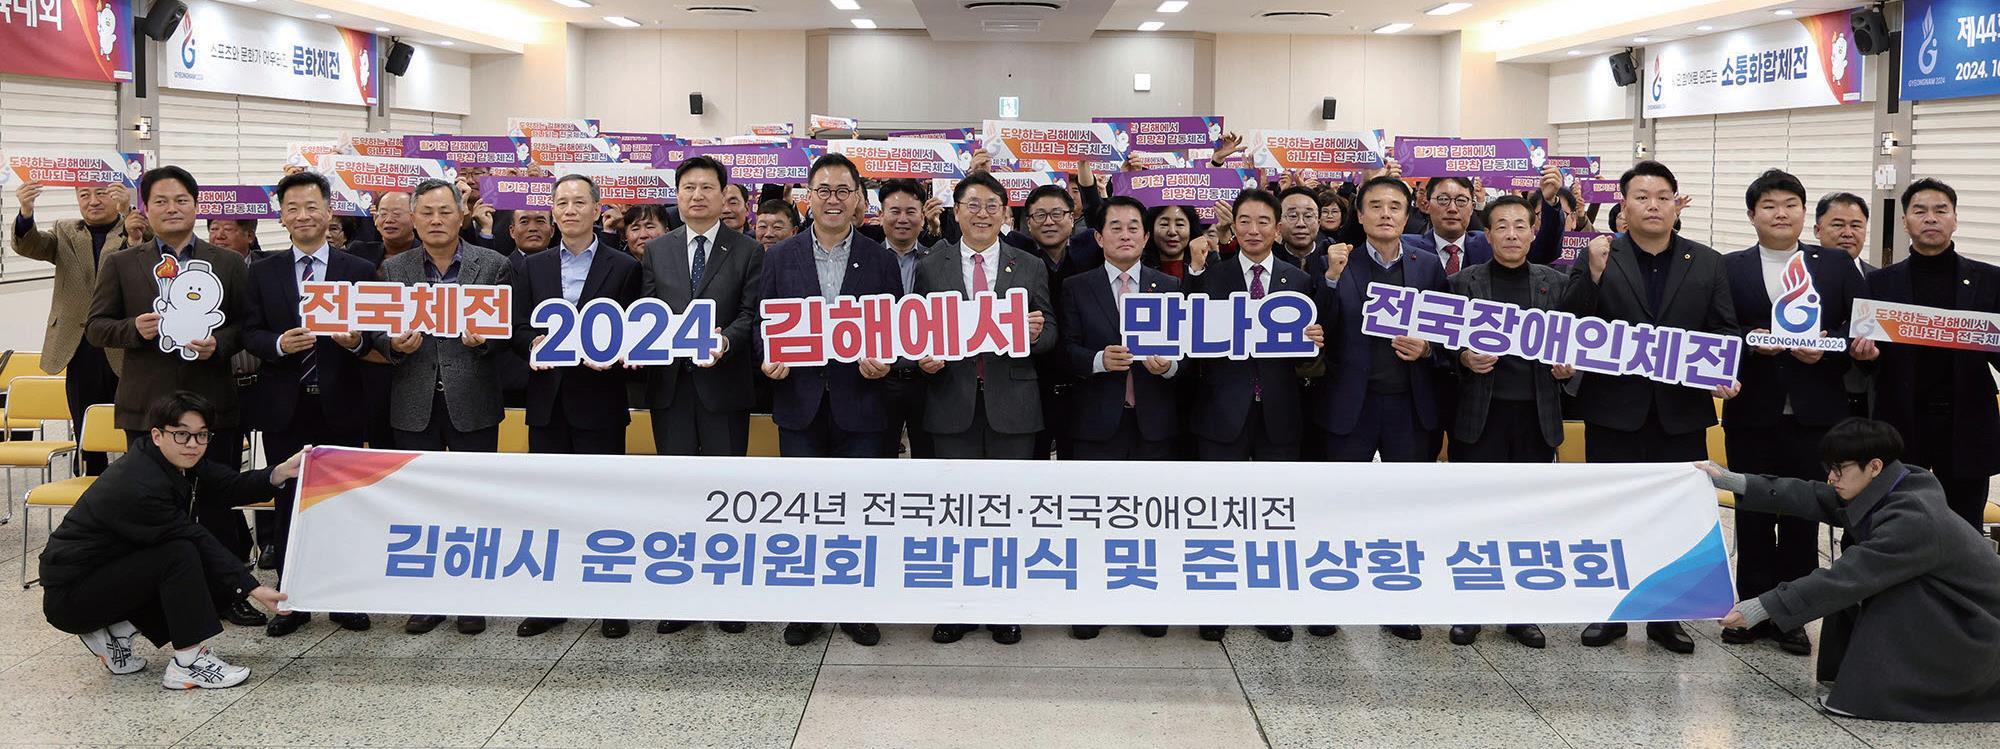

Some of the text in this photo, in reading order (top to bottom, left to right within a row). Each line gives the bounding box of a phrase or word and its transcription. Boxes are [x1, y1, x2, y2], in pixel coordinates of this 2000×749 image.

[1957, 13, 2000, 47] 제44
[241, 47, 261, 63] 문화가
[292, 45, 340, 80] 문화체전
[1721, 46, 1808, 86] 소통화합체전
[1955, 60, 1988, 80] 2024.
[1141, 122, 1179, 133] 김해에서
[1001, 128, 1091, 141] 도약하는 김해에서
[1136, 134, 1206, 144] 희망찬 감동체전
[352, 137, 386, 146] 도약하는
[420, 140, 488, 151] 활기찬 김해에서
[559, 143, 592, 151] 김해에서
[1267, 137, 1358, 150] 도약하는 김해에서
[368, 147, 401, 155] 하나되는
[846, 147, 933, 158] 도약하는 김해에서
[1020, 142, 1111, 155] 하나되는 전국체전
[1414, 145, 1495, 158] 활기찬 김해에서
[447, 153, 514, 162] 희망찬 감동체전
[540, 153, 607, 161] 하나되는 전국체전
[736, 154, 778, 165] 김해에서
[1287, 151, 1377, 162] 하나되는 전국체전
[10, 157, 101, 169] 도약하는 김해에서
[336, 162, 420, 174] 도약하는 김해에서
[865, 161, 954, 173] 하나되는 전국체전
[1446, 158, 1528, 171] 희망찬 감동체전
[30, 170, 123, 181] 하나되는 전국체전
[731, 167, 808, 178] 희망찬 감동체전
[354, 175, 395, 185] 하나되는
[618, 176, 659, 187] 김해에서
[1000, 178, 1031, 188] 해에서
[1131, 174, 1210, 189] 활기찬 김해에서
[498, 181, 529, 193] 활기찬
[638, 188, 678, 198] 전국체전
[1162, 188, 1240, 200] 희망찬 감동체전
[198, 204, 267, 214] 망찬 감동체전
[302, 284, 509, 335] 전국체전
[764, 290, 1025, 360] 김해에서
[1126, 296, 1313, 355] 만나요
[1876, 309, 1988, 330] 도약하는 김해에서
[535, 303, 717, 361] 2024
[1365, 285, 1738, 388] 전국장애인체전
[1899, 325, 1953, 341] 하나되는
[1748, 336, 1844, 349] GYEONGNAM 2024
[705, 491, 1296, 530] 2024년 전국체전·전국장애인체전
[385, 524, 1630, 591] 김해시 운영위원회 발대식 및 준비상황 설명회
